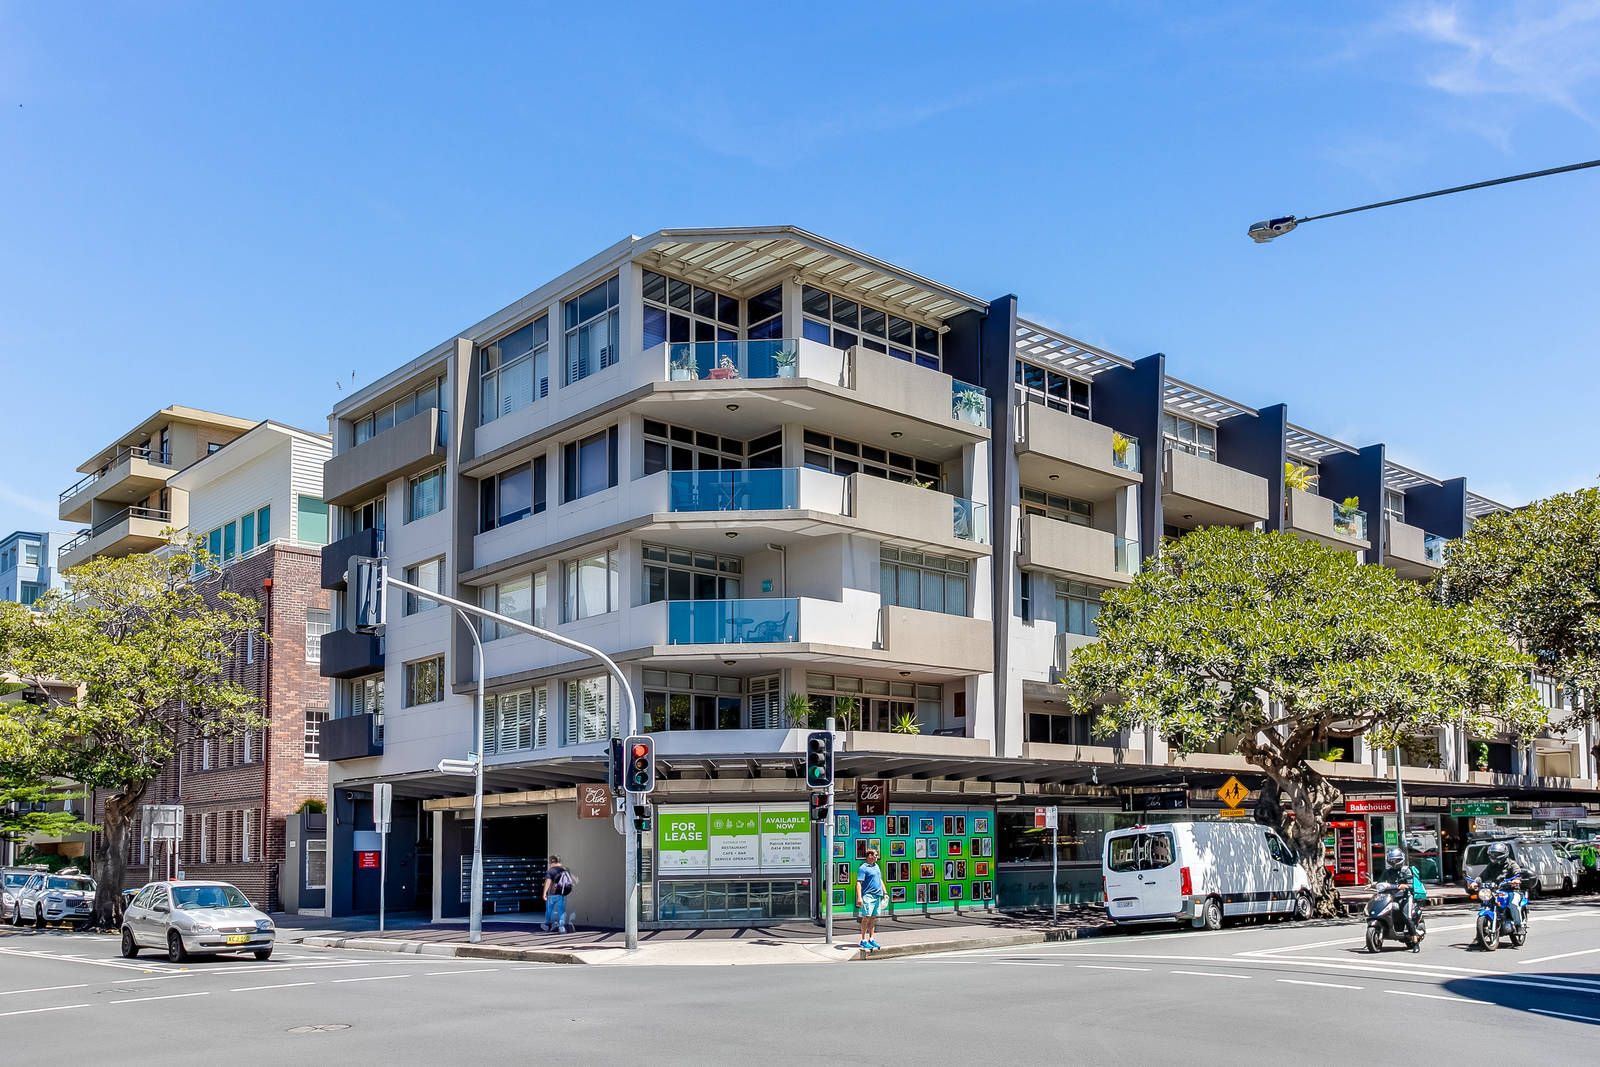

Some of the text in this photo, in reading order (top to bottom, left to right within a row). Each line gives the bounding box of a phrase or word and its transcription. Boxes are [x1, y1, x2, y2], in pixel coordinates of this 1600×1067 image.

[1350, 803, 1391, 811] Bakehouse
[671, 822, 696, 831] FOR
[665, 832, 702, 841] LEASE
